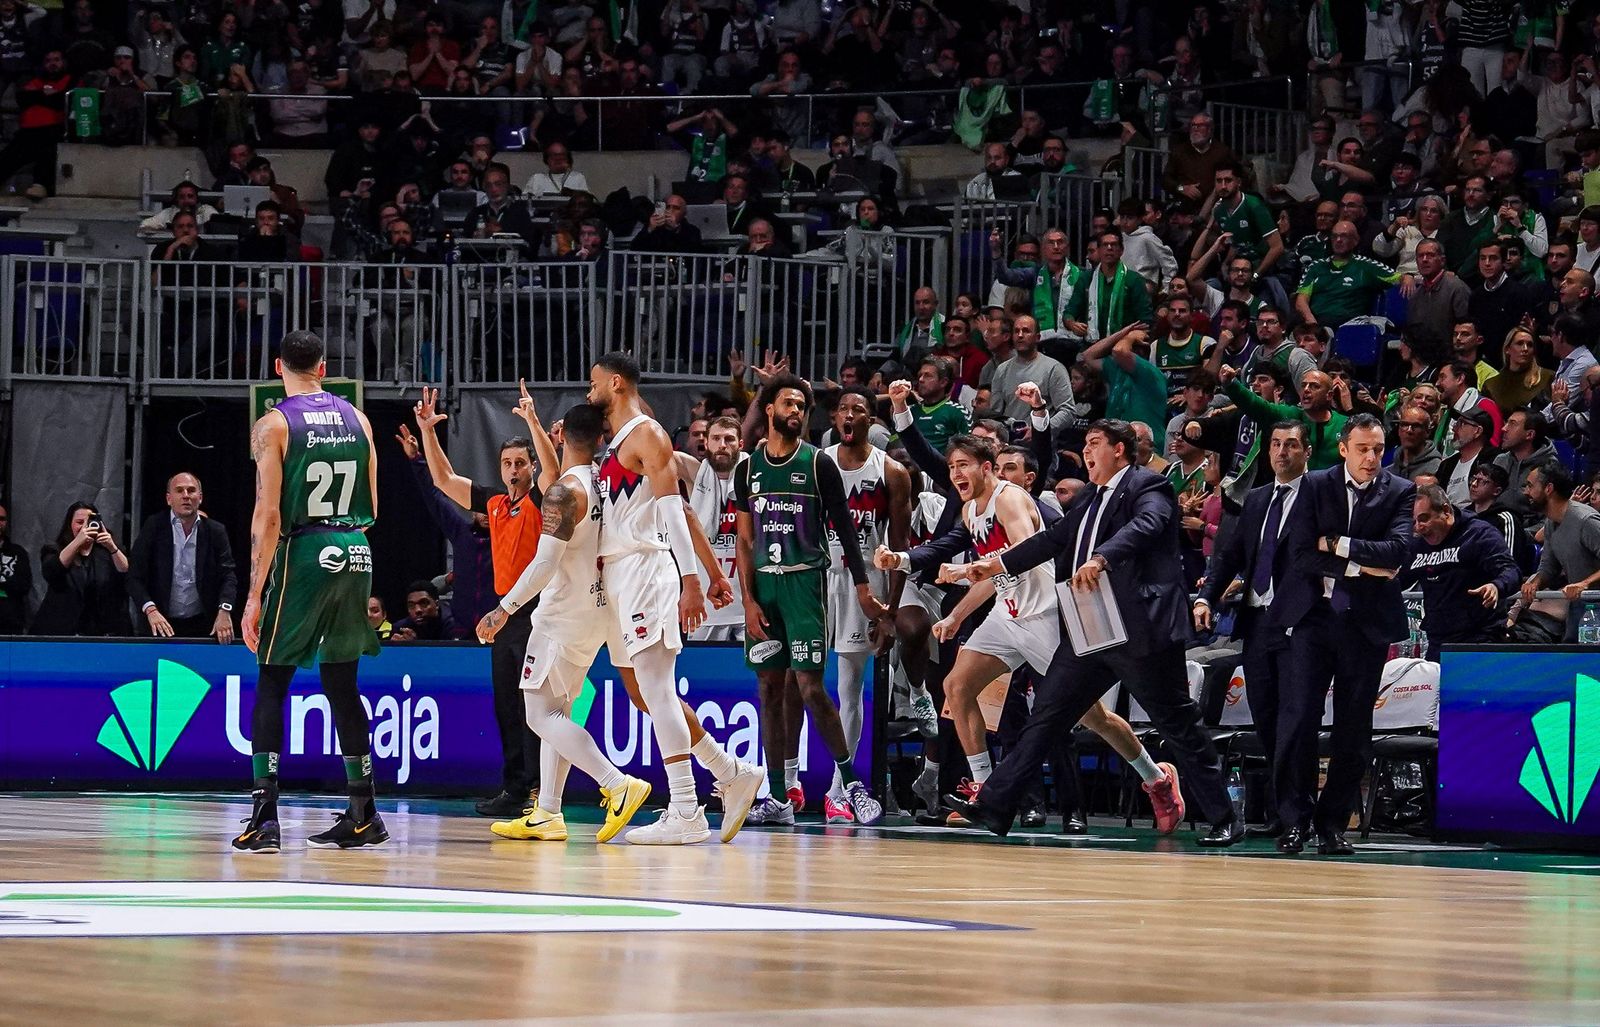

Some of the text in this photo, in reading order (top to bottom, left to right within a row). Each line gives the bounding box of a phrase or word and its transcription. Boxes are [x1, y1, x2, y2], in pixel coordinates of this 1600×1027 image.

[302, 411, 344, 426] DUARTE
[306, 460, 357, 517] 27
[766, 500, 803, 515] Unicaja
[768, 542, 782, 564] 3
[349, 563, 373, 573] MÁLAG
